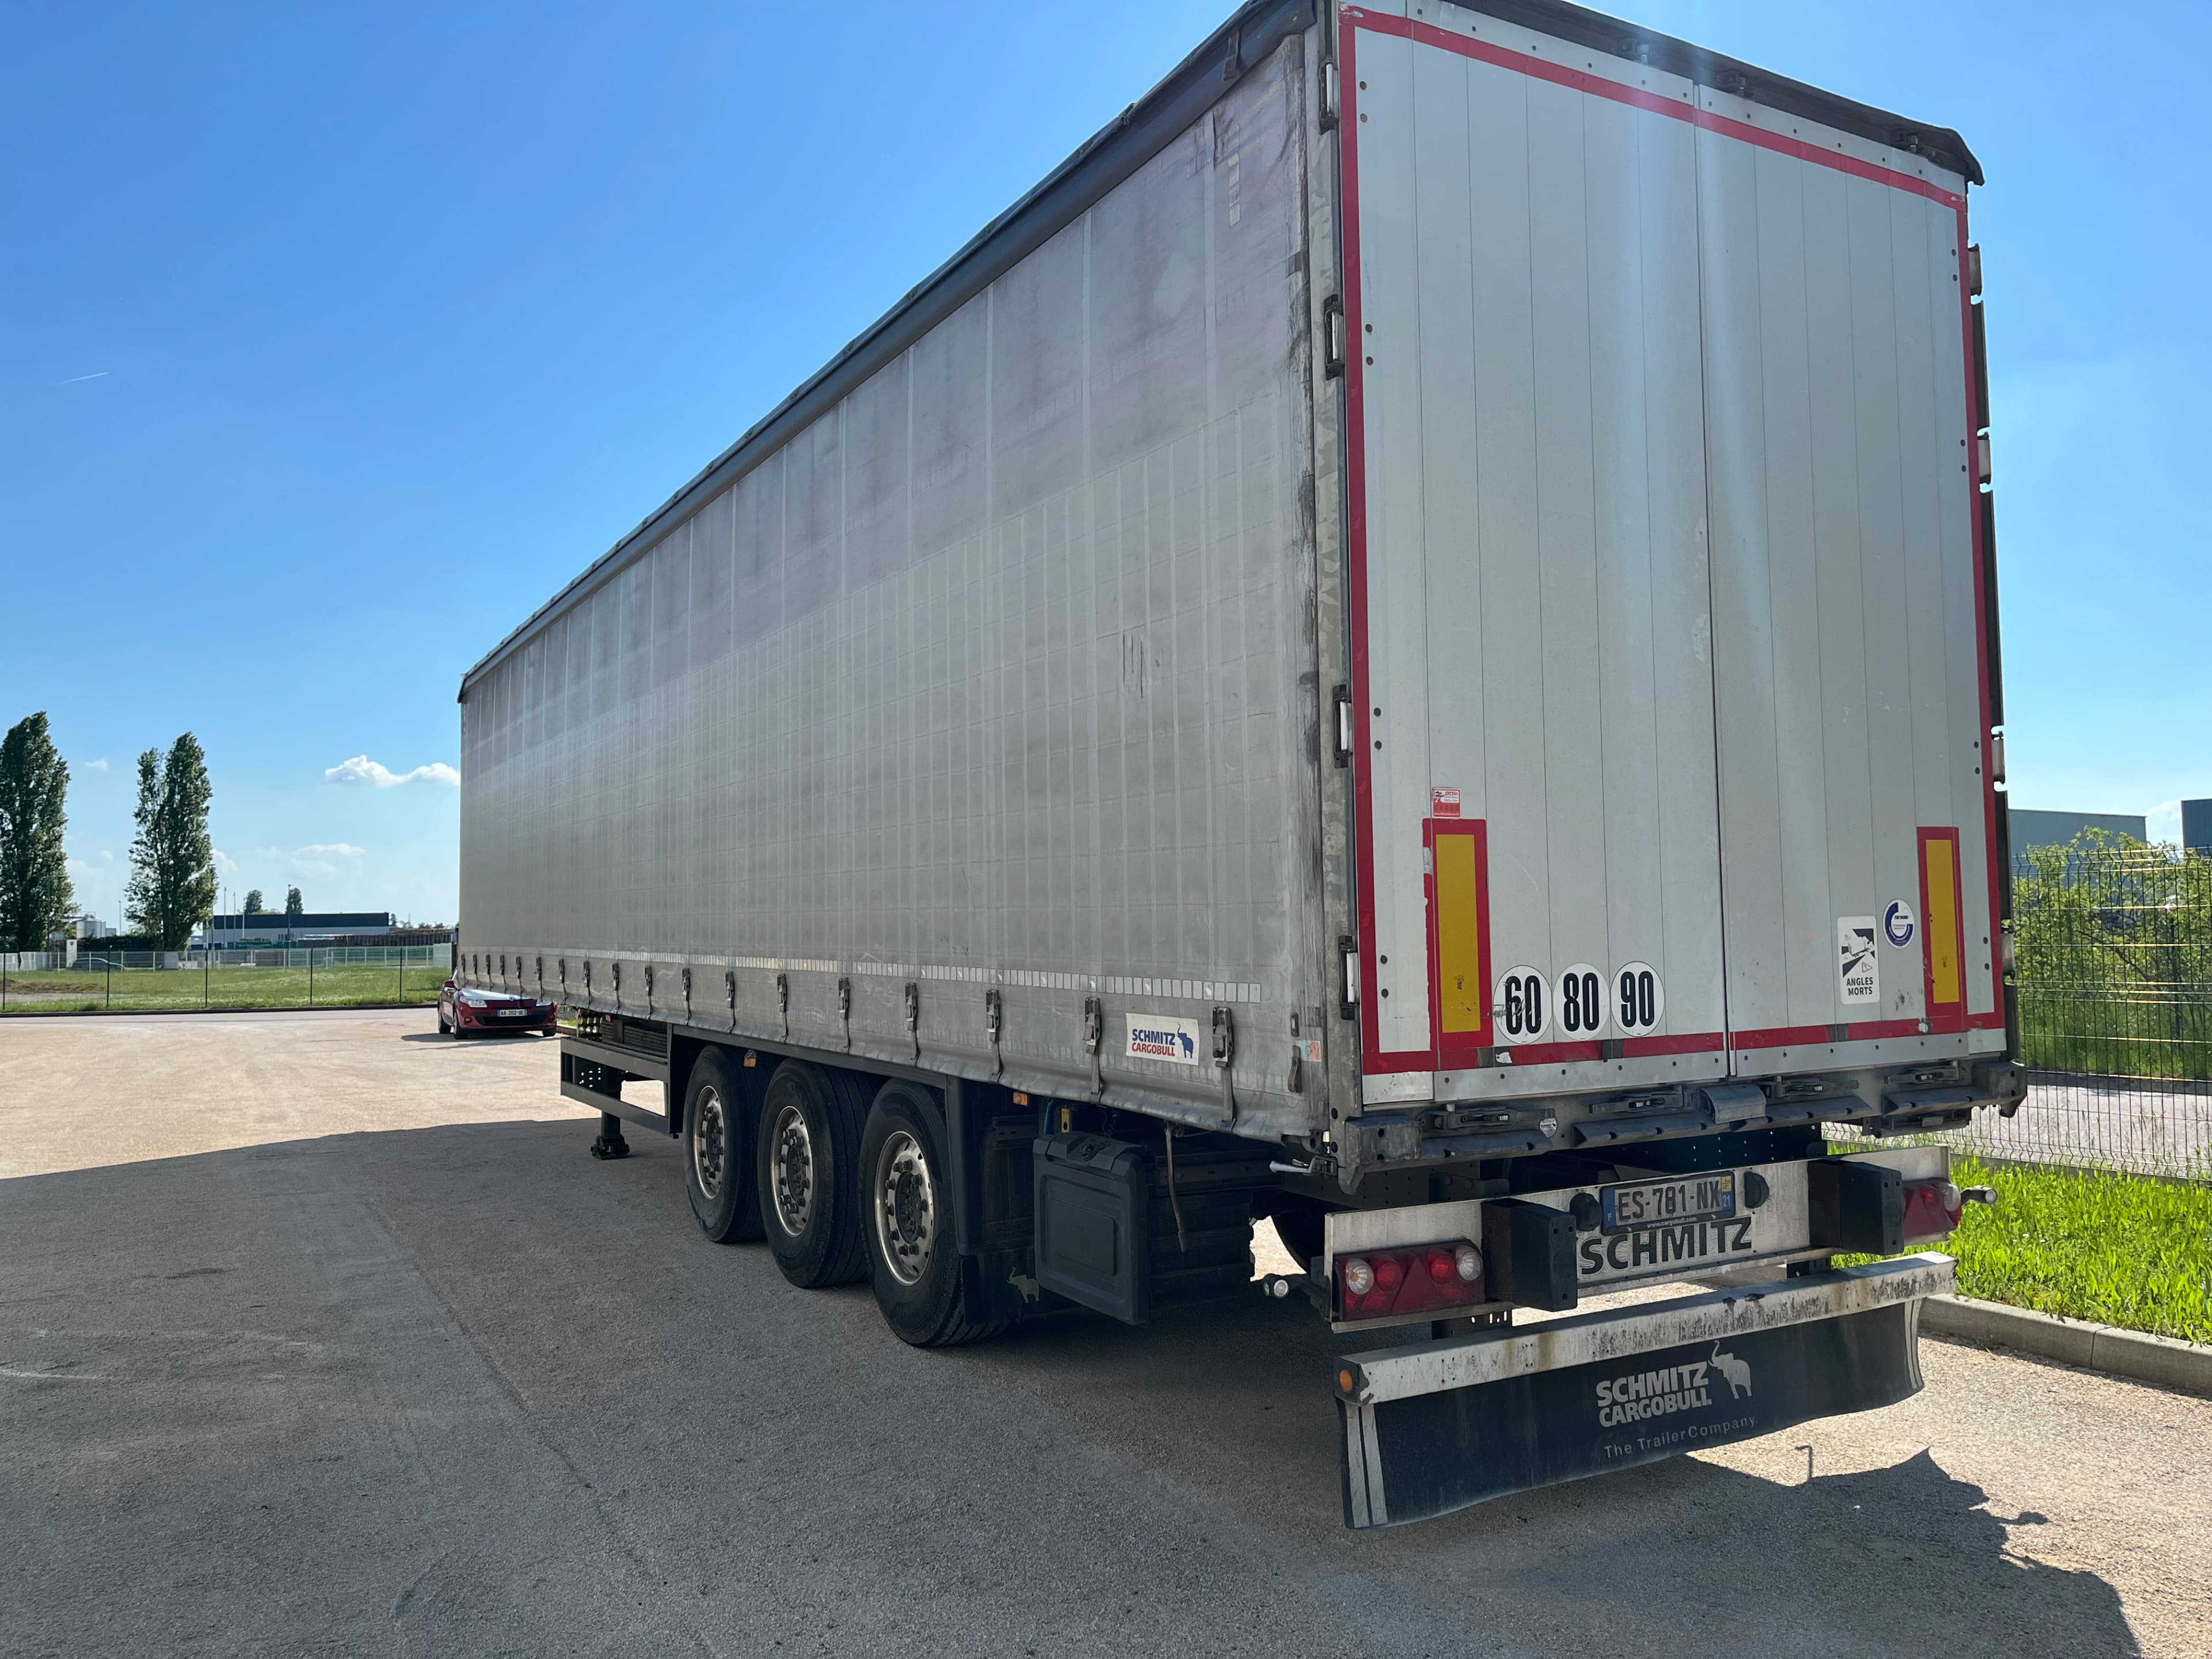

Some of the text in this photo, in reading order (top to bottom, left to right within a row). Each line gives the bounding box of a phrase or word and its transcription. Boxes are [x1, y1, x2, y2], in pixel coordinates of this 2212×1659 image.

[1846, 978, 1873, 986] ANGLES
[1620, 971, 1655, 1028] 90
[1849, 987, 1873, 995] MORTS
[1505, 975, 1541, 1035] 60
[1563, 972, 1600, 1032] 80
[1132, 1029, 1176, 1046] SCHMITZ
[1132, 1042, 1175, 1056] CARGOBULL
[1618, 1180, 1720, 1221] ES-781-NX
[1722, 1195, 1730, 1207] 21
[1608, 1214, 1612, 1222] F
[1646, 1217, 1697, 1229] www.cargobull.com
[1580, 1217, 1752, 1275] SCHMITZ
[1596, 1361, 1709, 1407] SCHMITZ
[1599, 1387, 1712, 1427] CARGOBULL
[1604, 1444, 1633, 1459] The
